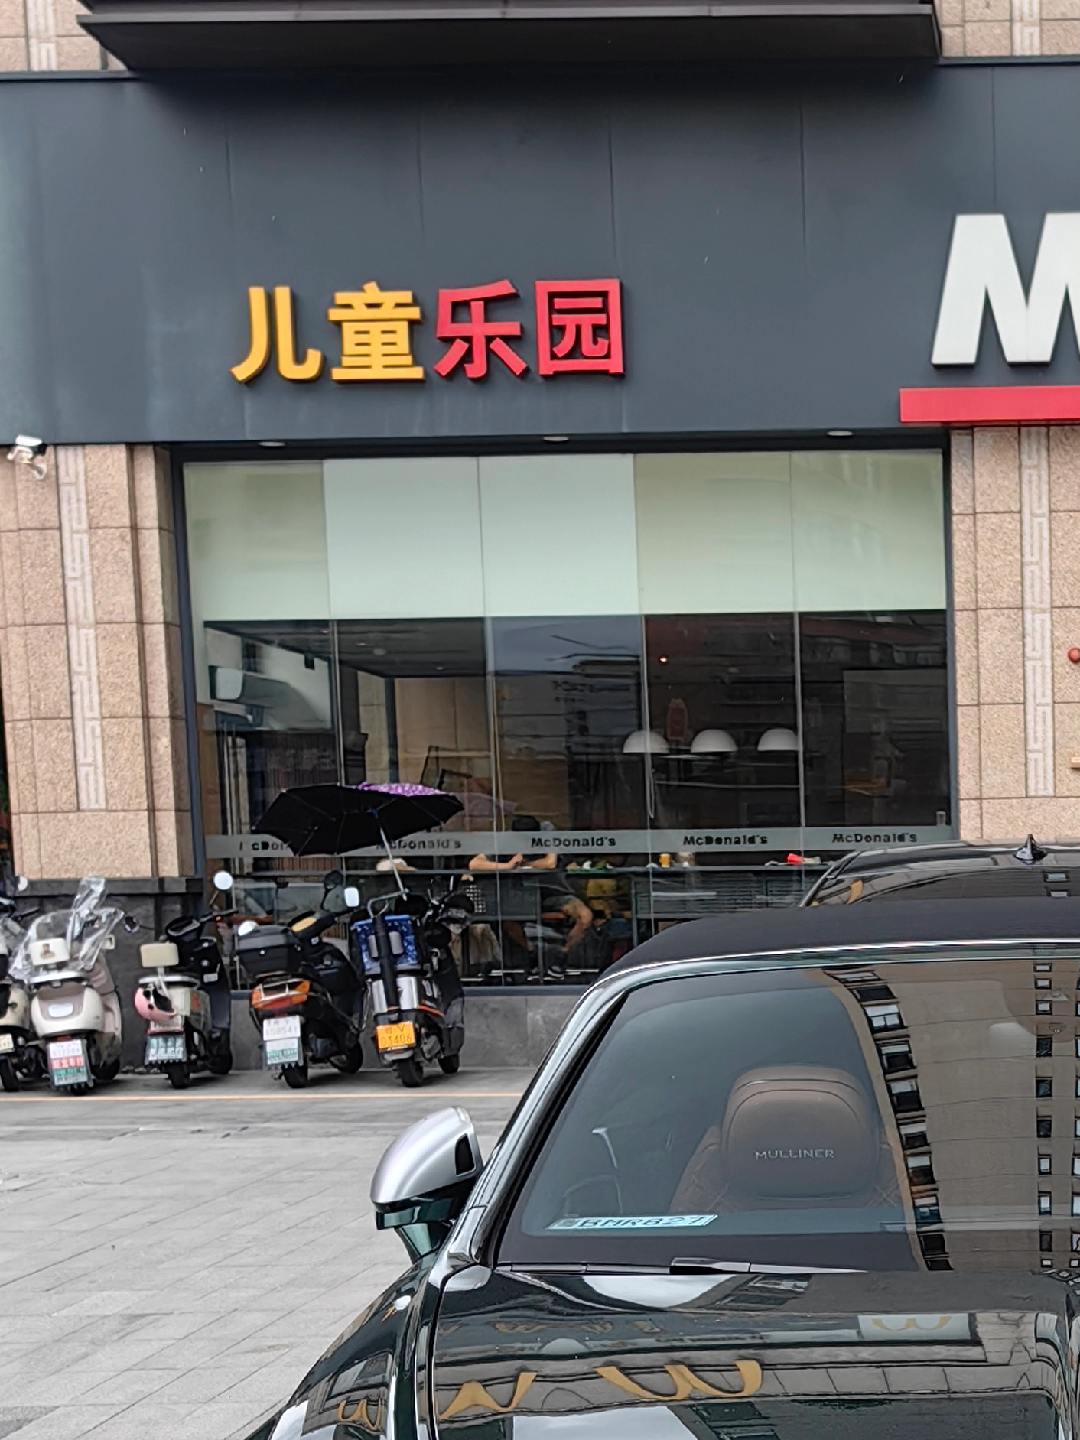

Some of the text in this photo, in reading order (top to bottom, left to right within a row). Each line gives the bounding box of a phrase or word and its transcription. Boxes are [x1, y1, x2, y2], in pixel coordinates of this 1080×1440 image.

[231, 278, 626, 385] 儿童乐园
[531, 836, 617, 848] McDonald's
[683, 834, 768, 846] McDonald's
[831, 832, 917, 844] McDonald's
[755, 1148, 835, 1161] MULLINER
